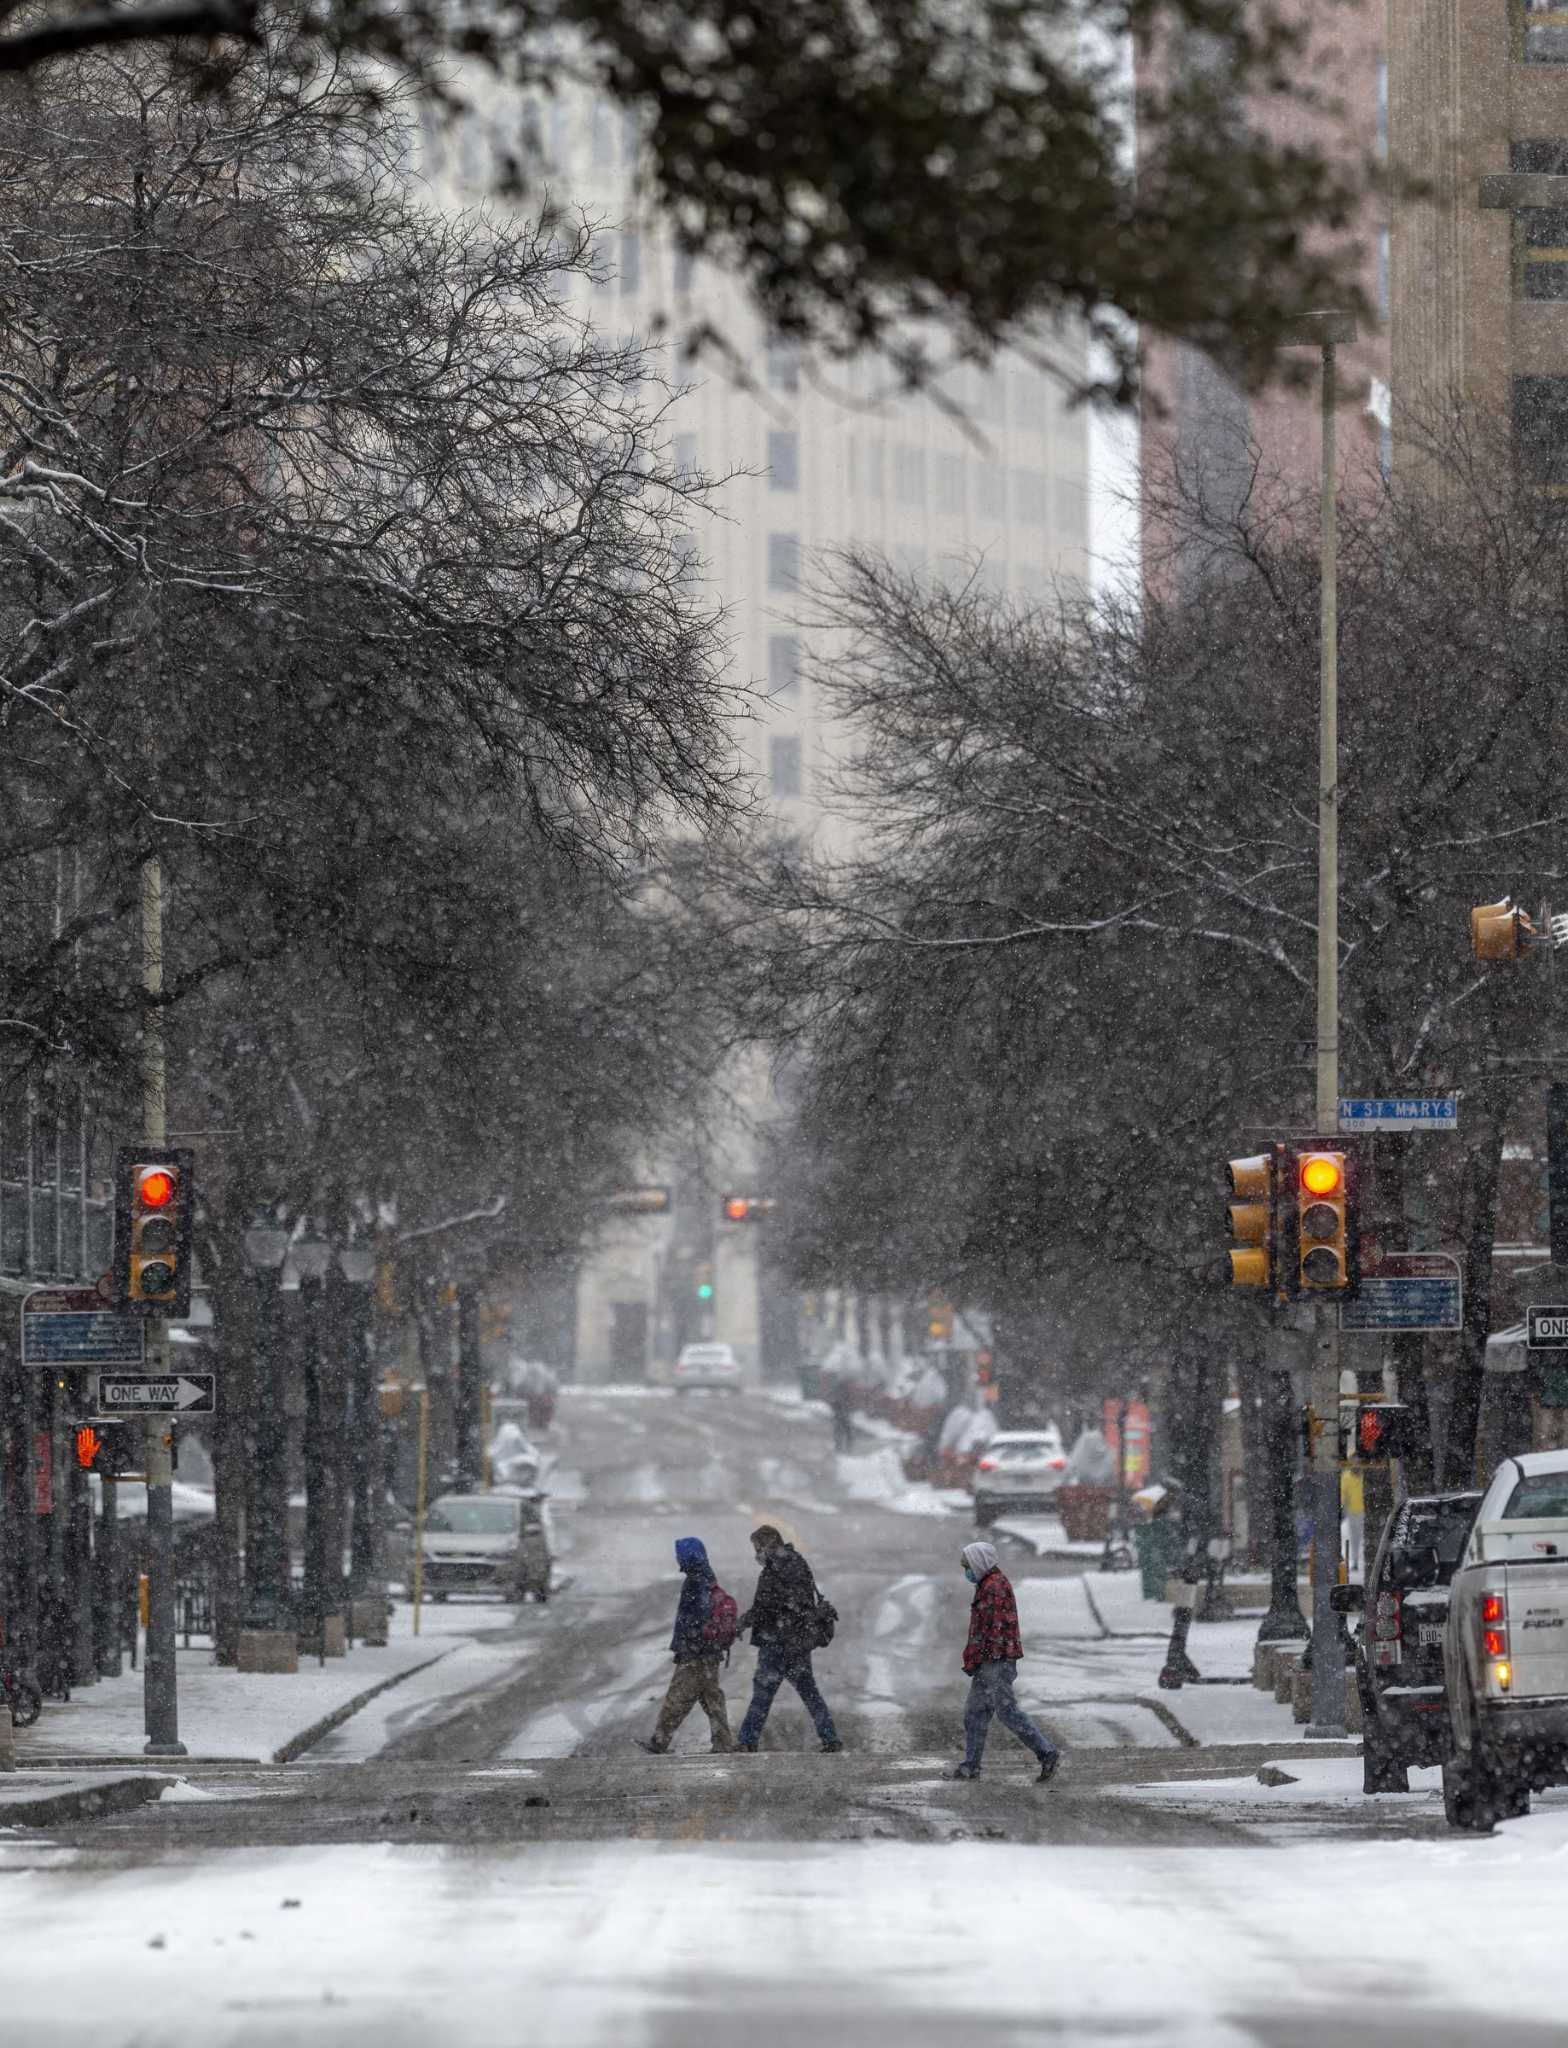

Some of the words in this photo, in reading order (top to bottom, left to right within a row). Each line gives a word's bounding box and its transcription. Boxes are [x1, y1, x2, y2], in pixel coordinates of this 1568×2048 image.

[1343, 1102, 1352, 1117] N
[1364, 1102, 1383, 1117] ST
[1396, 1102, 1453, 1117] MARYS
[111, 1386, 140, 1401] ONE
[148, 1386, 179, 1401] WAY
